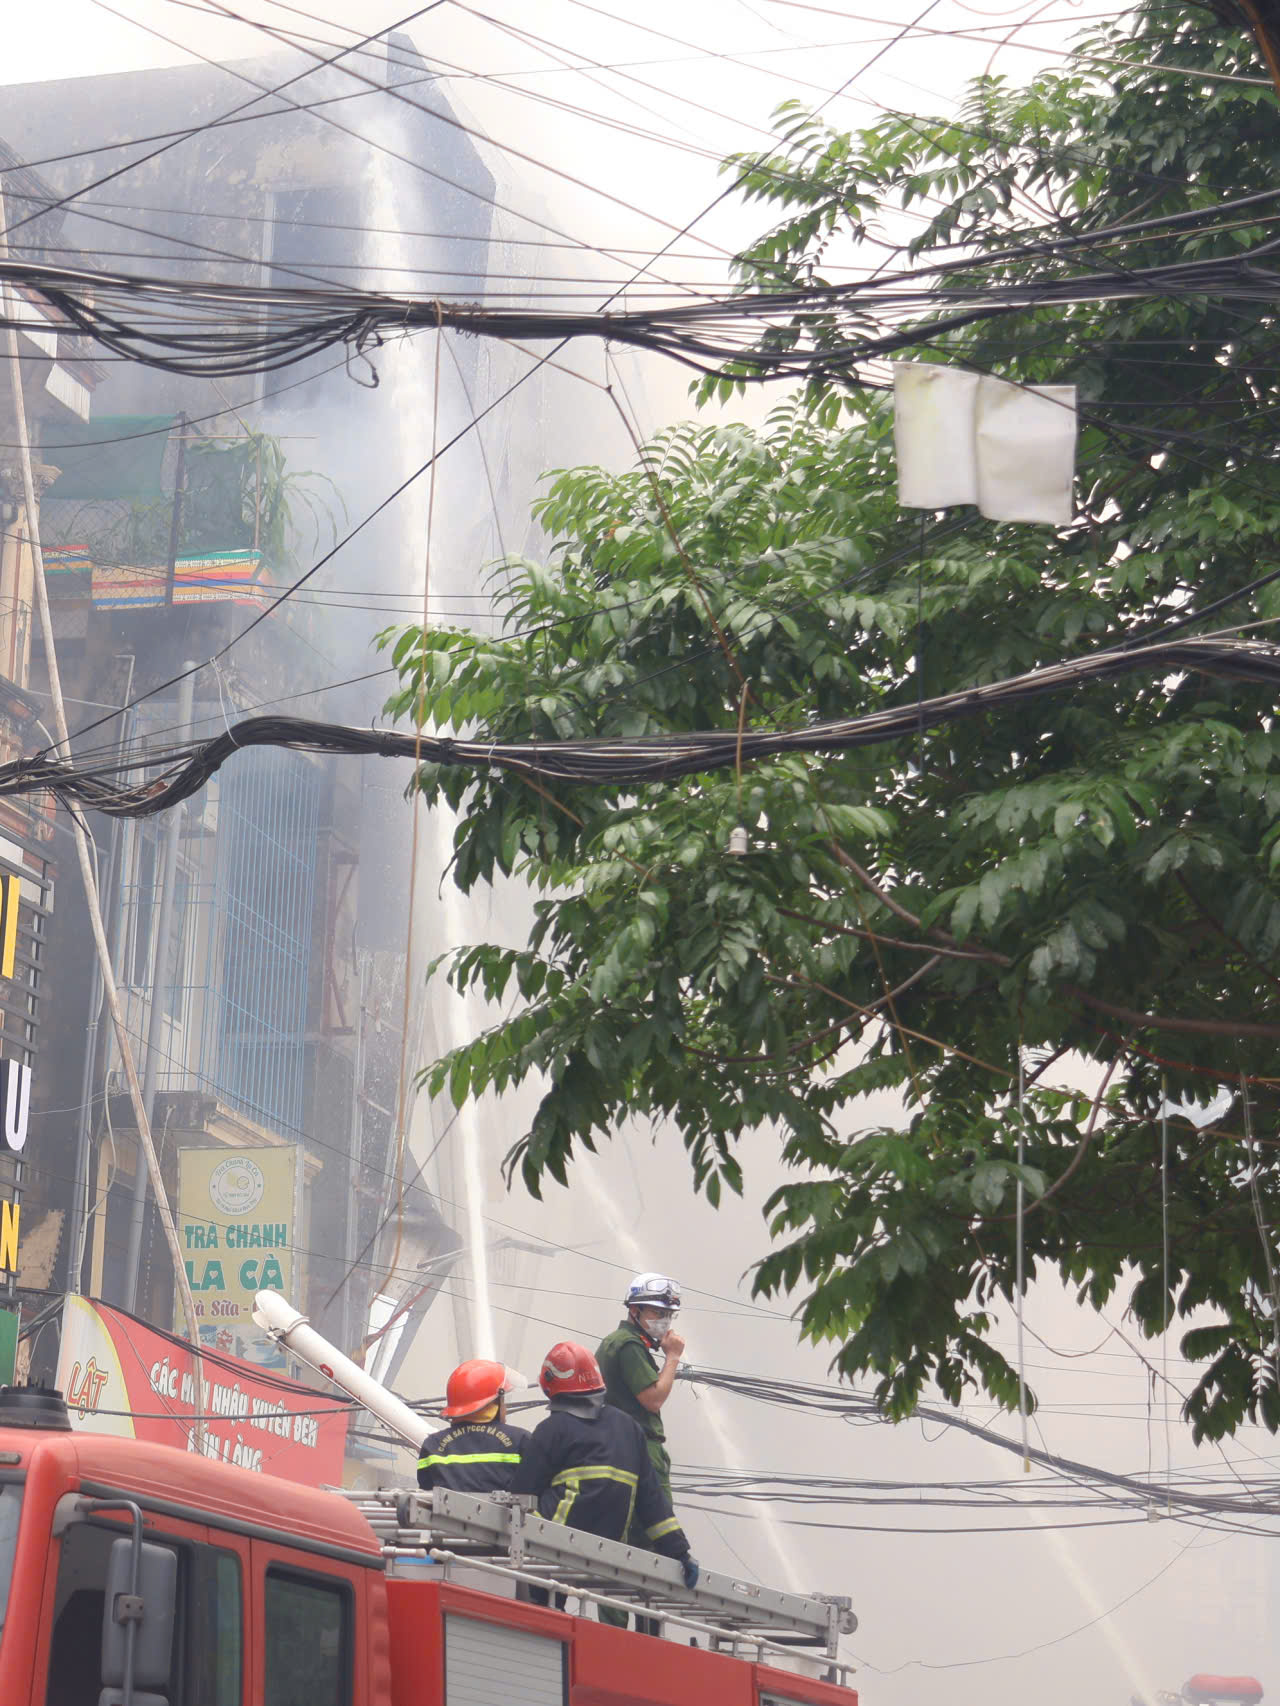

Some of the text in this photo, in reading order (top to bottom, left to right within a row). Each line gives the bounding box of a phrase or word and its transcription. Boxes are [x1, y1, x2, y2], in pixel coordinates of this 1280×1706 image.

[225, 1223, 287, 1249] CHANH
[184, 1253, 284, 1291] LA CÀ
[67, 1357, 108, 1420] LẬT
[151, 1357, 178, 1399] CÁC
[212, 1383, 248, 1427] NHẬU
[251, 1399, 291, 1440] XUYÊN
